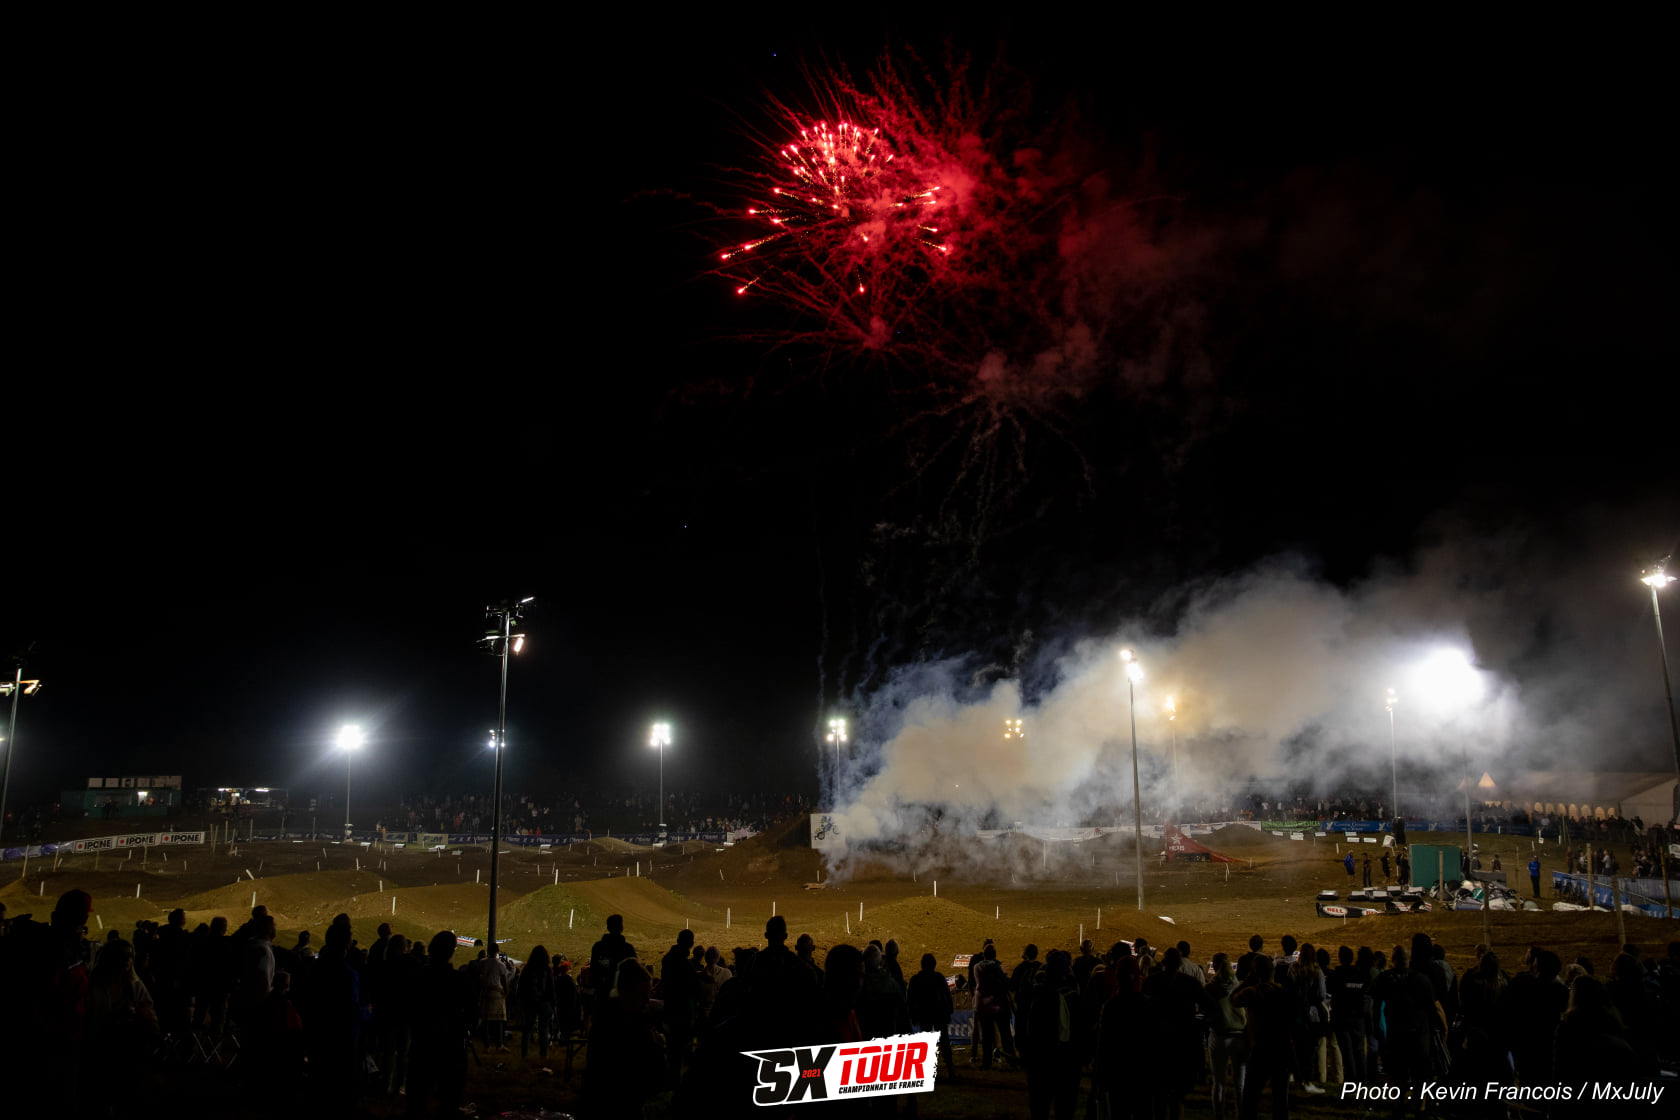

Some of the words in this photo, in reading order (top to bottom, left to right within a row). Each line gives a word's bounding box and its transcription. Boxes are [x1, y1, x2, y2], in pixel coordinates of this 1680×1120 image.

[126, 836, 154, 845] IPONE
[170, 834, 199, 842] IPONE
[84, 840, 111, 849] IPONE
